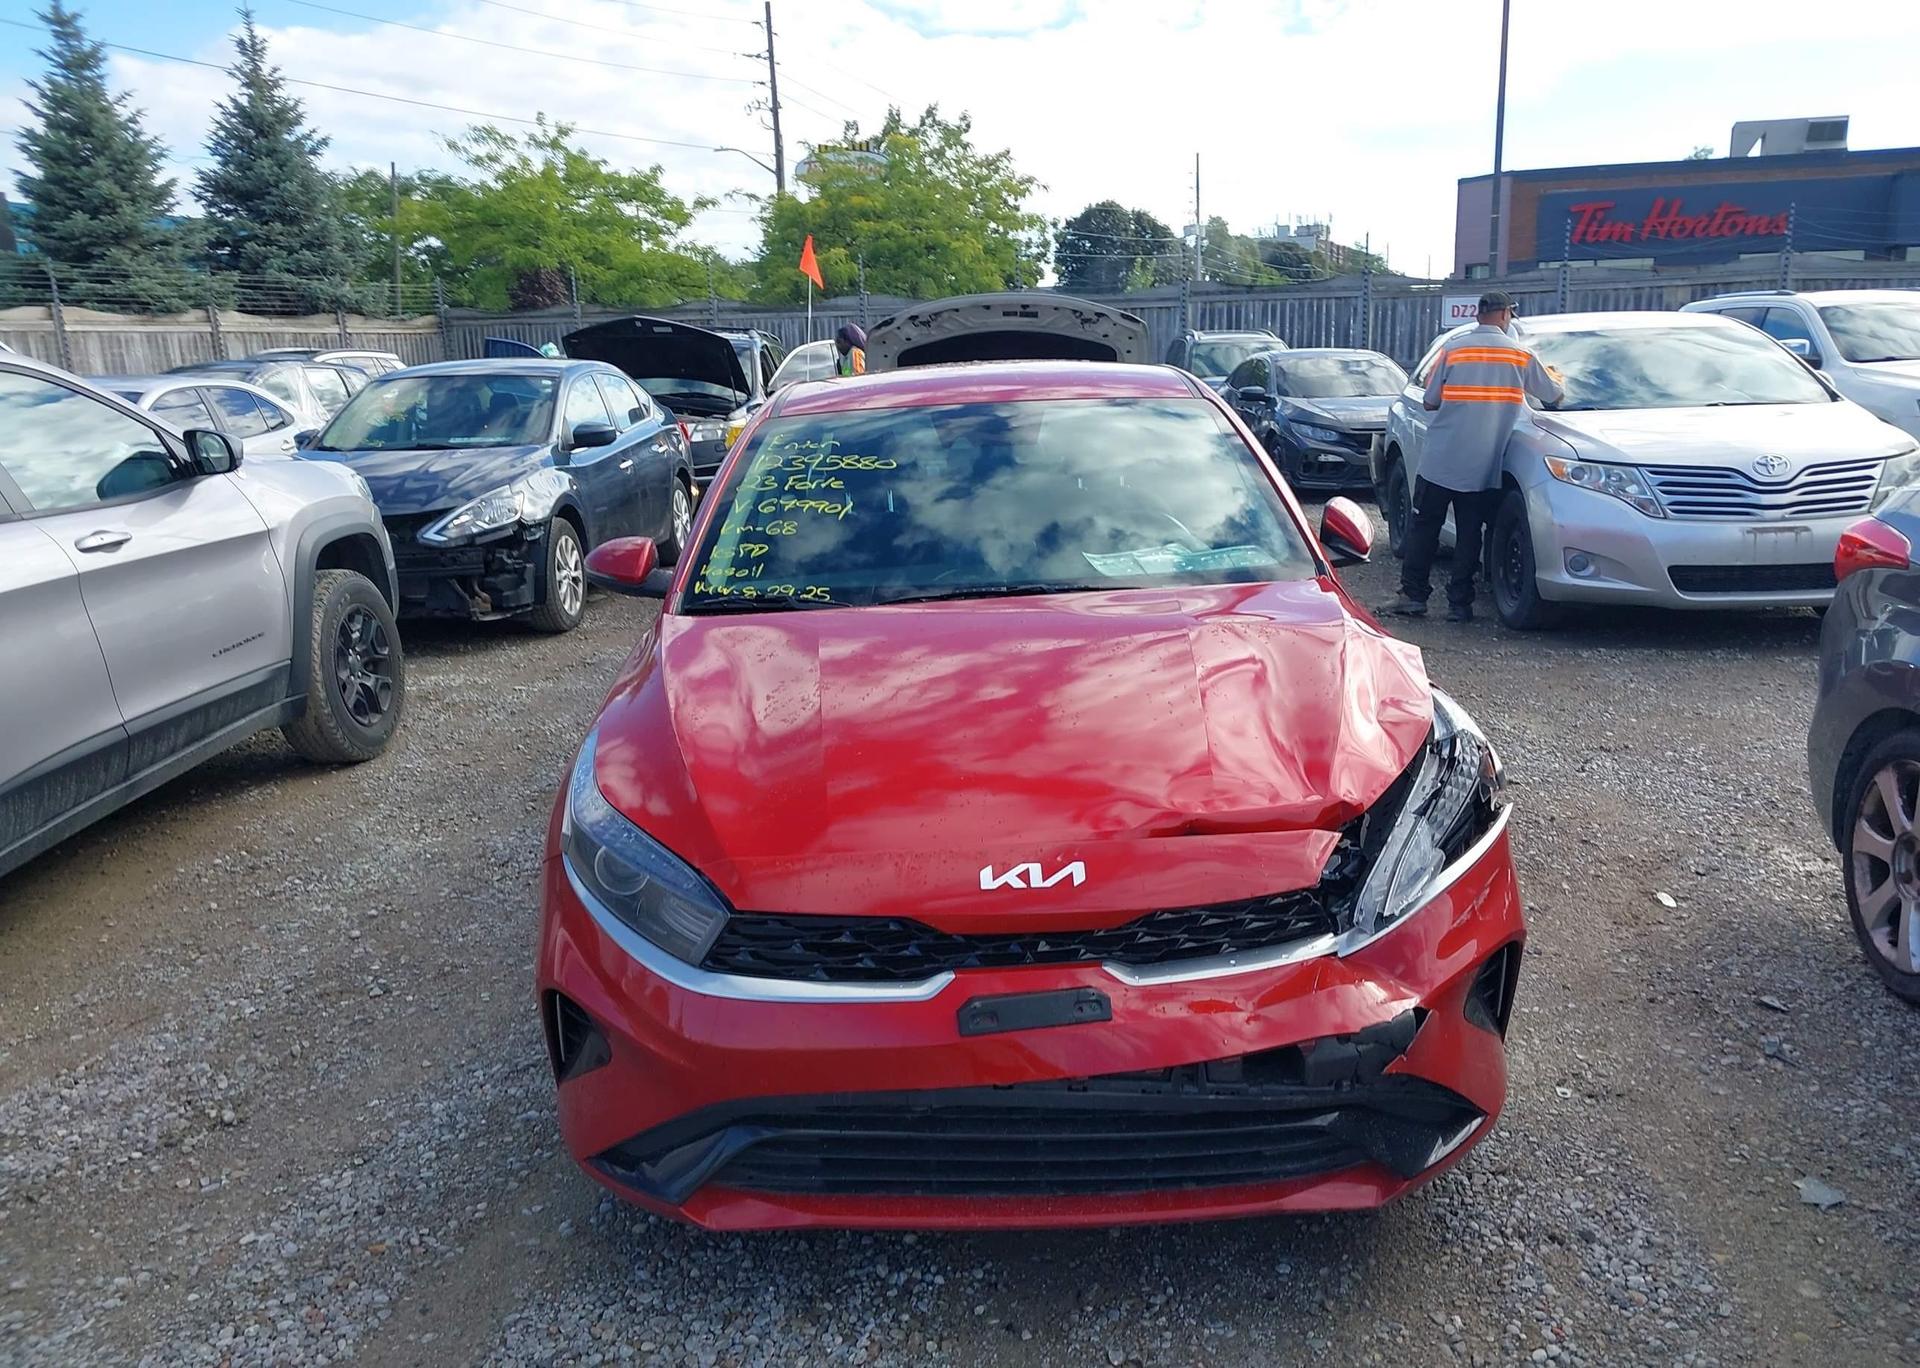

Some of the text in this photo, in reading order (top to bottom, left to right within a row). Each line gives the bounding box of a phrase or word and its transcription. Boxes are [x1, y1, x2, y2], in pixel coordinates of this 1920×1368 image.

[1569, 197, 1788, 244] Tim Hortons
[979, 861, 1086, 890] KIA
